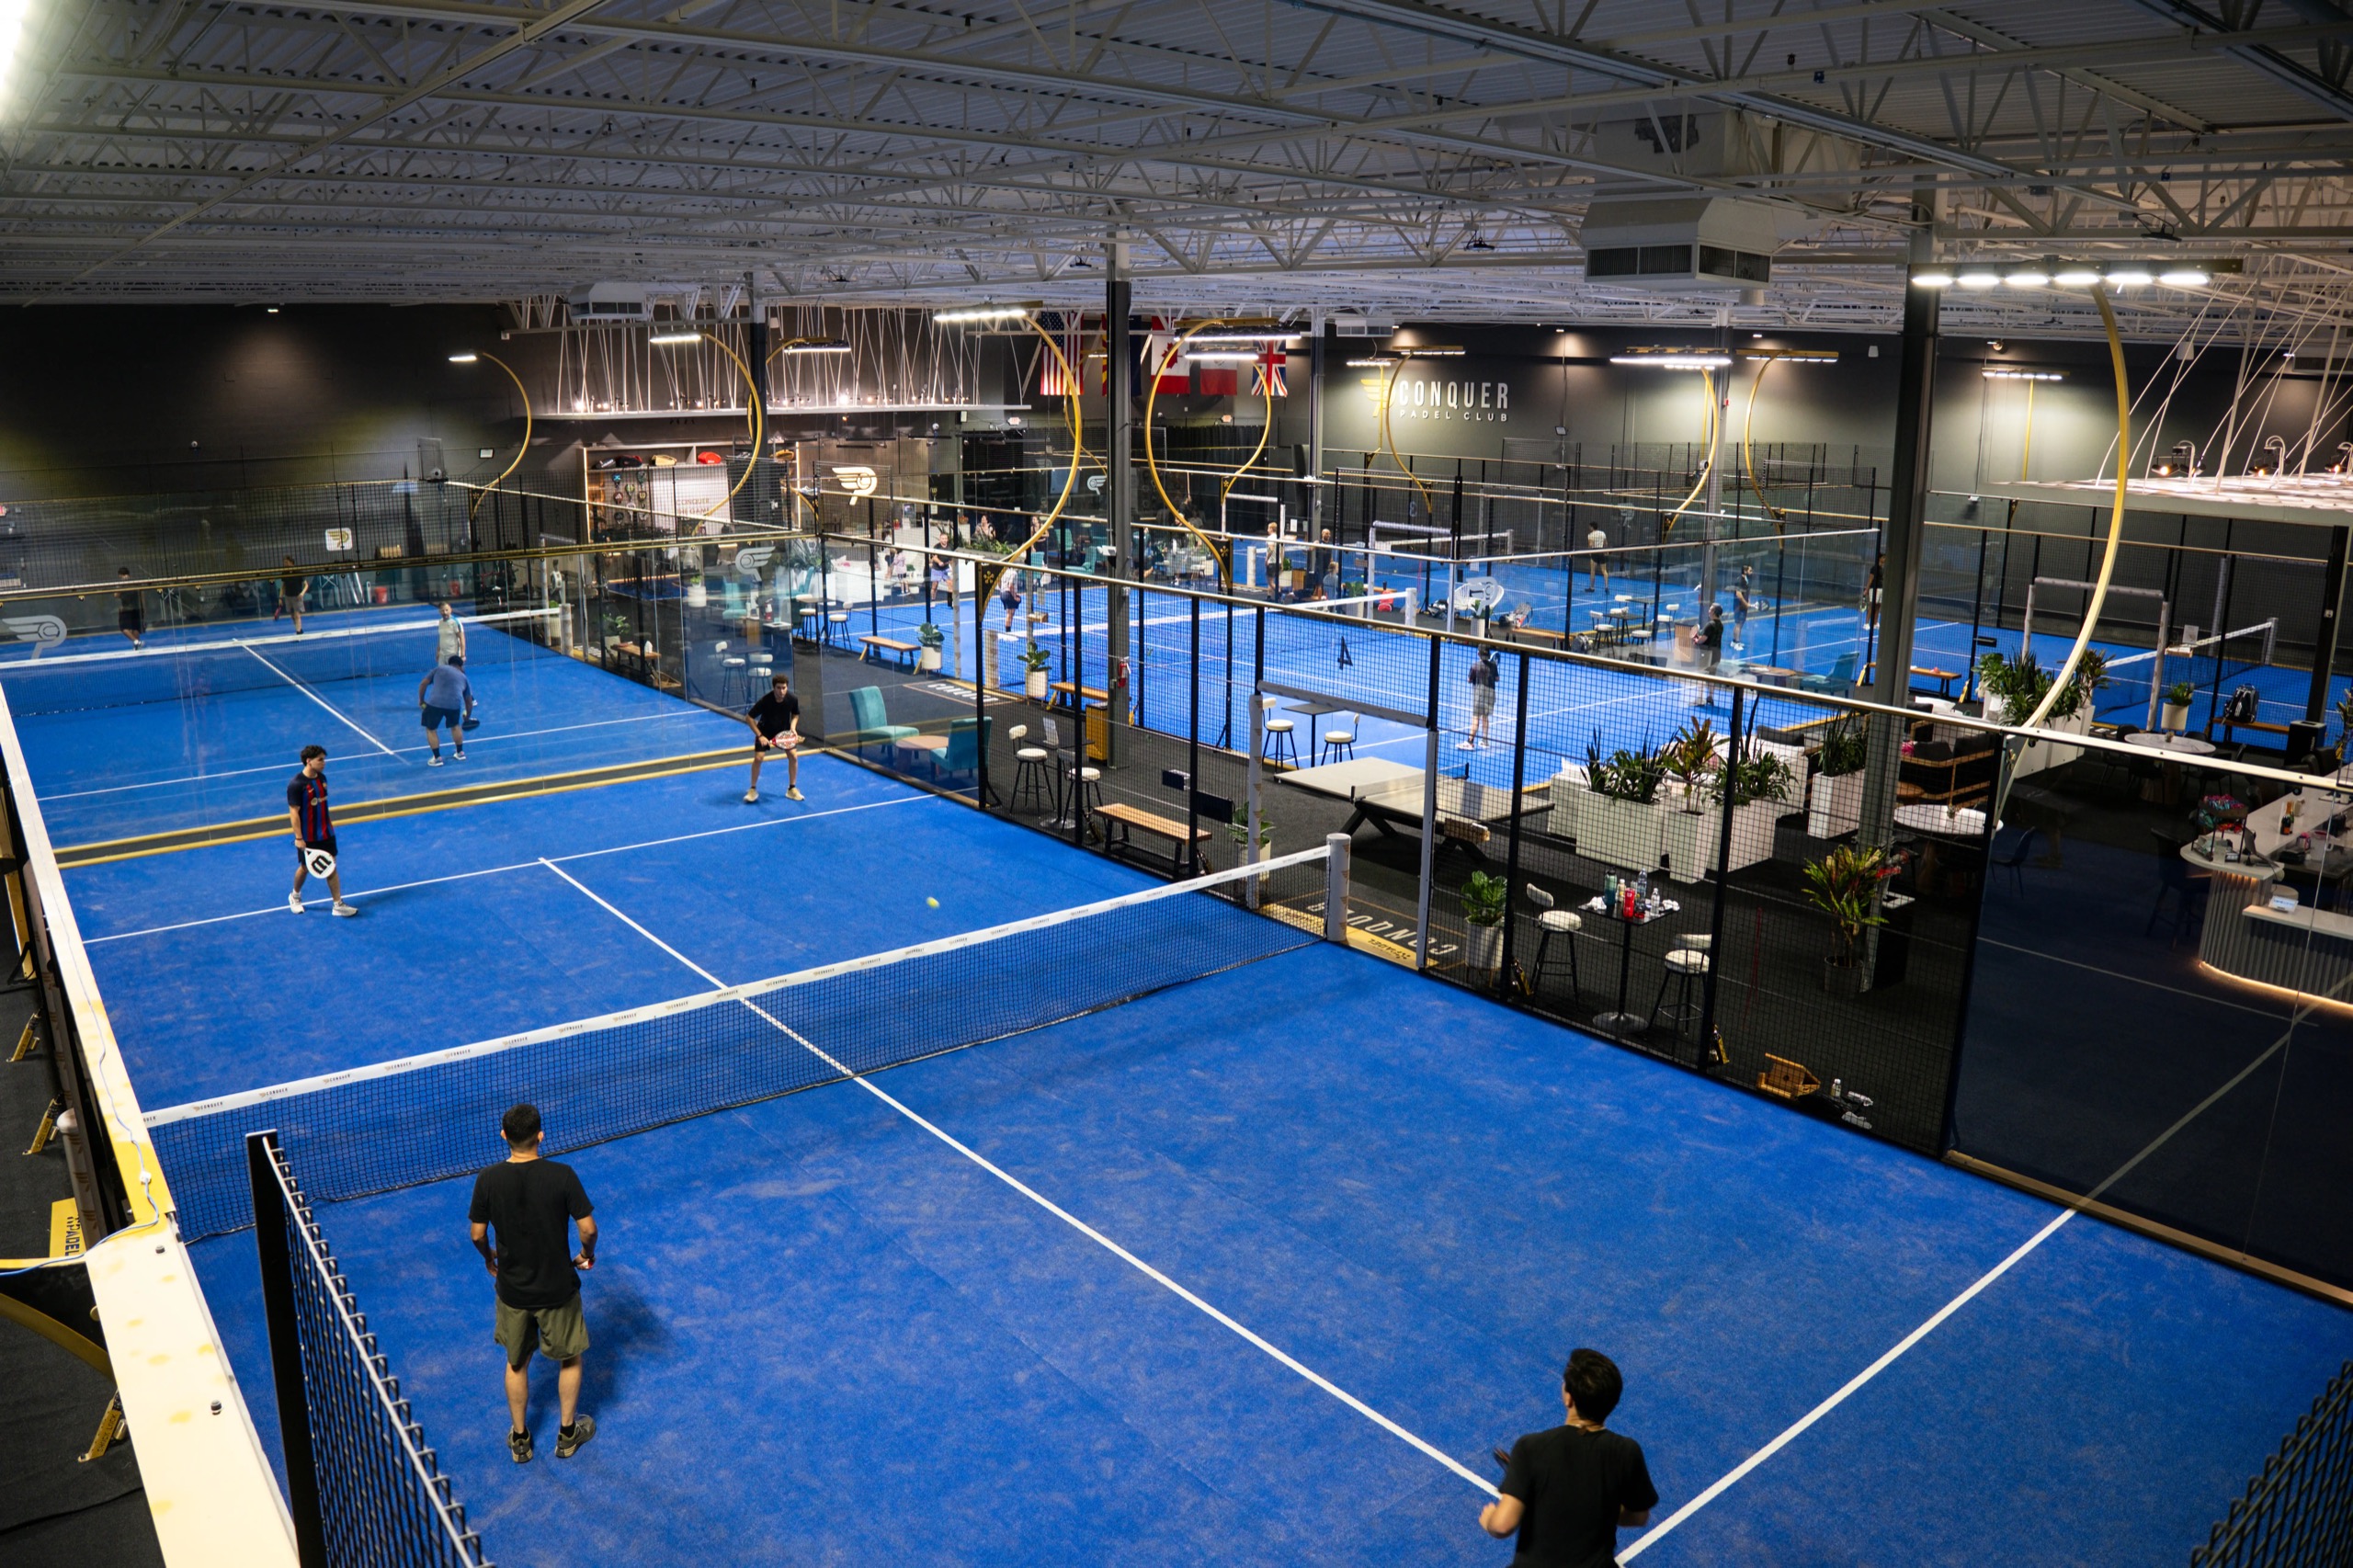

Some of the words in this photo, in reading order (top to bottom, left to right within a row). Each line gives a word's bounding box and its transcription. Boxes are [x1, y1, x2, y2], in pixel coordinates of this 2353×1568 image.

[1398, 379, 1509, 409] CONQUER
[1399, 410, 1452, 420] PADEL
[1463, 412, 1508, 422] CLUB
[1305, 901, 1460, 957] CONQUR
[265, 1087, 289, 1096] CONQUER
[199, 1101, 223, 1110] CONQUER
